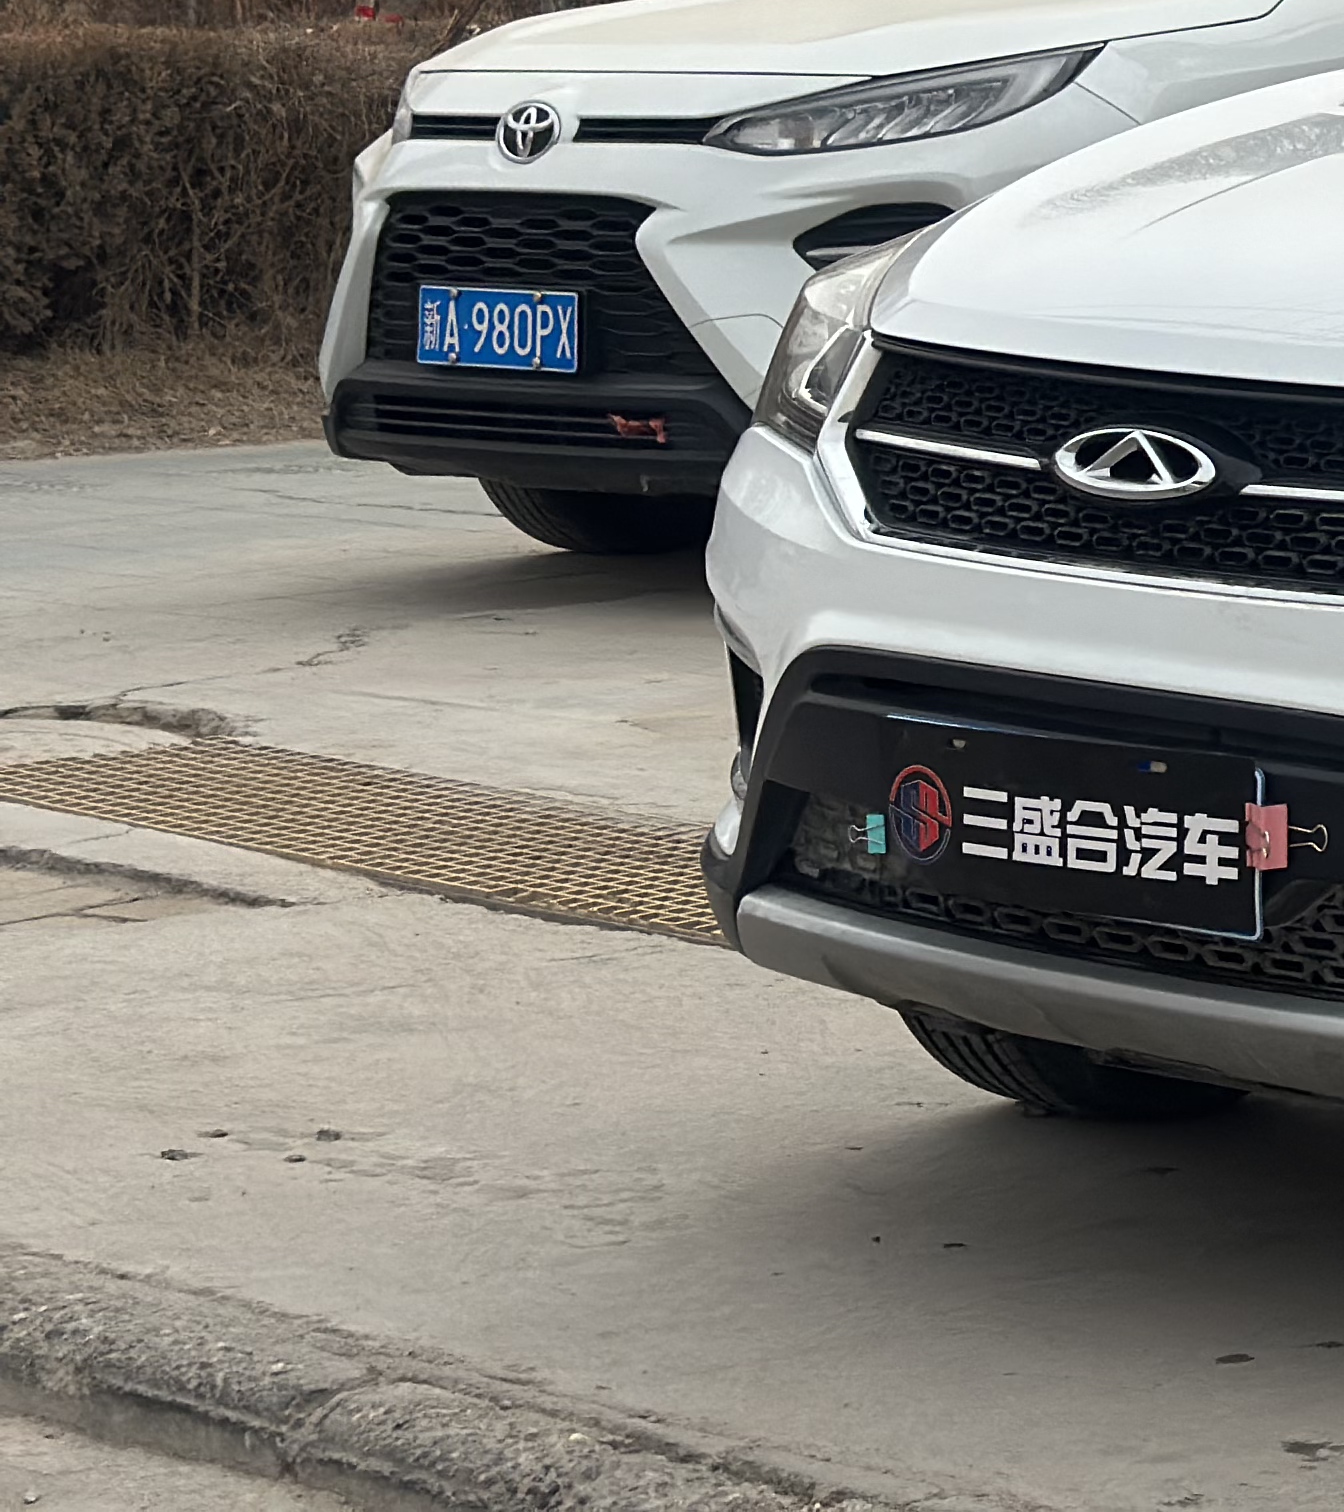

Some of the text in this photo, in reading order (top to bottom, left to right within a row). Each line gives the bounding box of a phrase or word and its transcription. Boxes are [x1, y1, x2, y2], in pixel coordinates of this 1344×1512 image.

[962, 785, 1240, 885] 三盛合汽车
